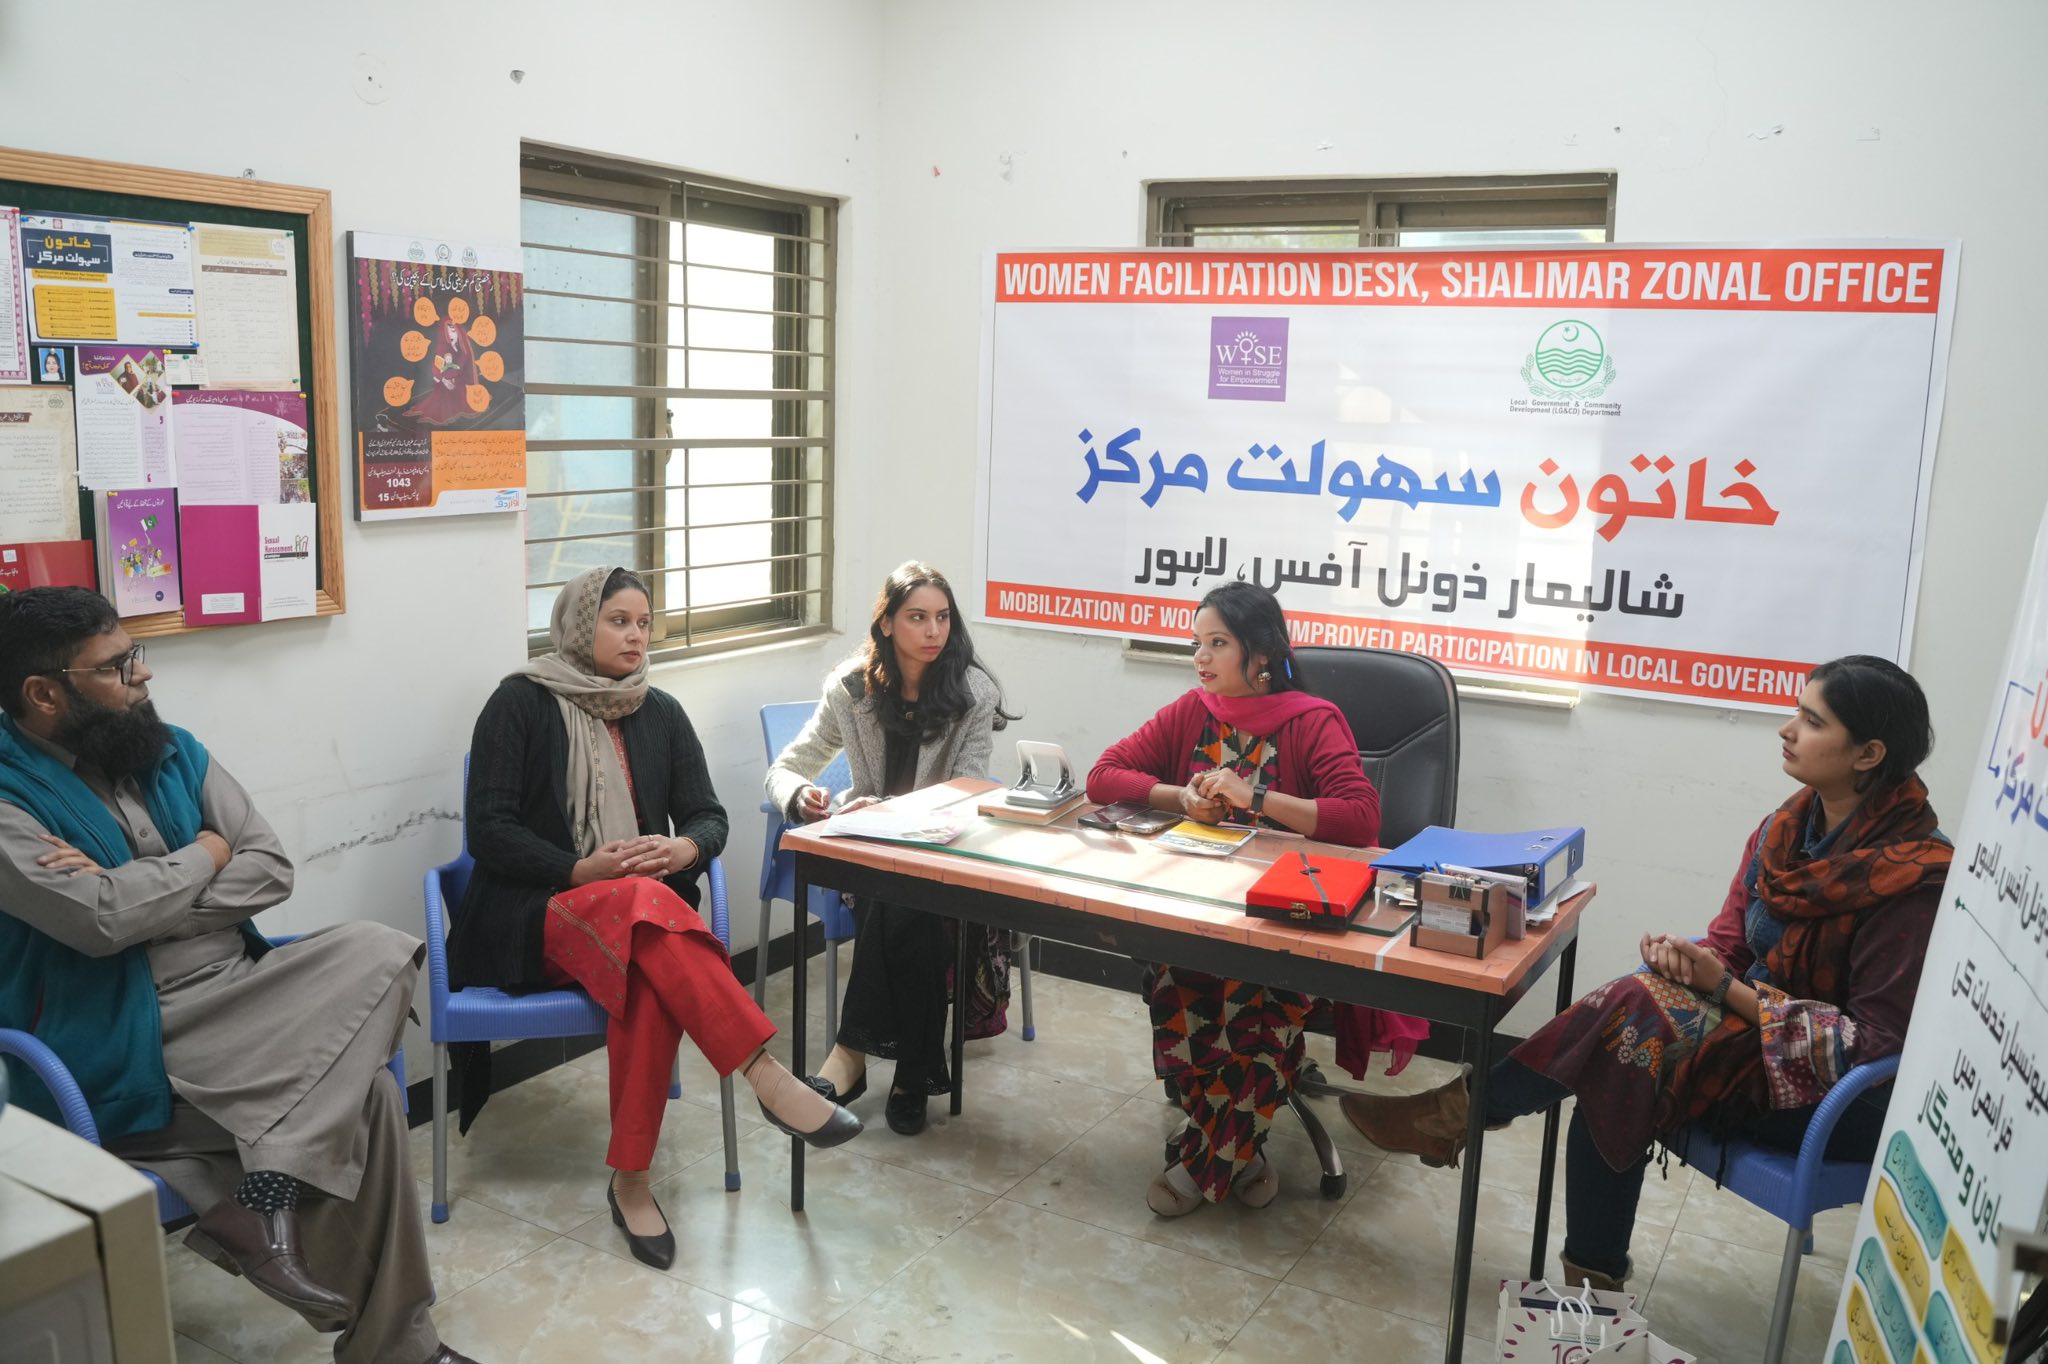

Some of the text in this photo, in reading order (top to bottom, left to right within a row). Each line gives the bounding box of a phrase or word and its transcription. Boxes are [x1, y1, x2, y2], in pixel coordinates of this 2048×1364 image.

[37, 250, 64, 264] مرکز
[45, 236, 92, 250] خاتون
[460, 278, 470, 292] عمر
[1004, 261, 1933, 304] WOMEN FACILITATION DESK, SHALIMAR ZONAL OFFICE
[1218, 368, 1243, 376] Women
[1252, 369, 1280, 378] Struggle
[1230, 376, 1278, 385] Empowerment
[1584, 401, 1622, 410] Community
[386, 478, 411, 488] 1043
[1076, 427, 1209, 508] مرکز
[378, 493, 390, 502] 15
[1520, 453, 1780, 543] خاتون
[1135, 536, 1227, 587] لاہور
[1497, 562, 1684, 623] شالیمار
[1000, 590, 1126, 623] MOBILIZATION
[1130, 604, 1155, 625] OF
[1284, 619, 1394, 650] IMPROVED
[1401, 631, 1568, 672] PARTICIPATION
[1575, 652, 1599, 674] IN
[1606, 653, 1683, 684] LOCAL
[1691, 662, 1807, 697] GOVERNM
[1952, 958, 1976, 997] کی
[1953, 1048, 1976, 1091] میں
[2001, 1020, 2048, 1118] یونسپل
[1917, 1080, 1964, 1174] مددگار
[1958, 1164, 1974, 1207] و
